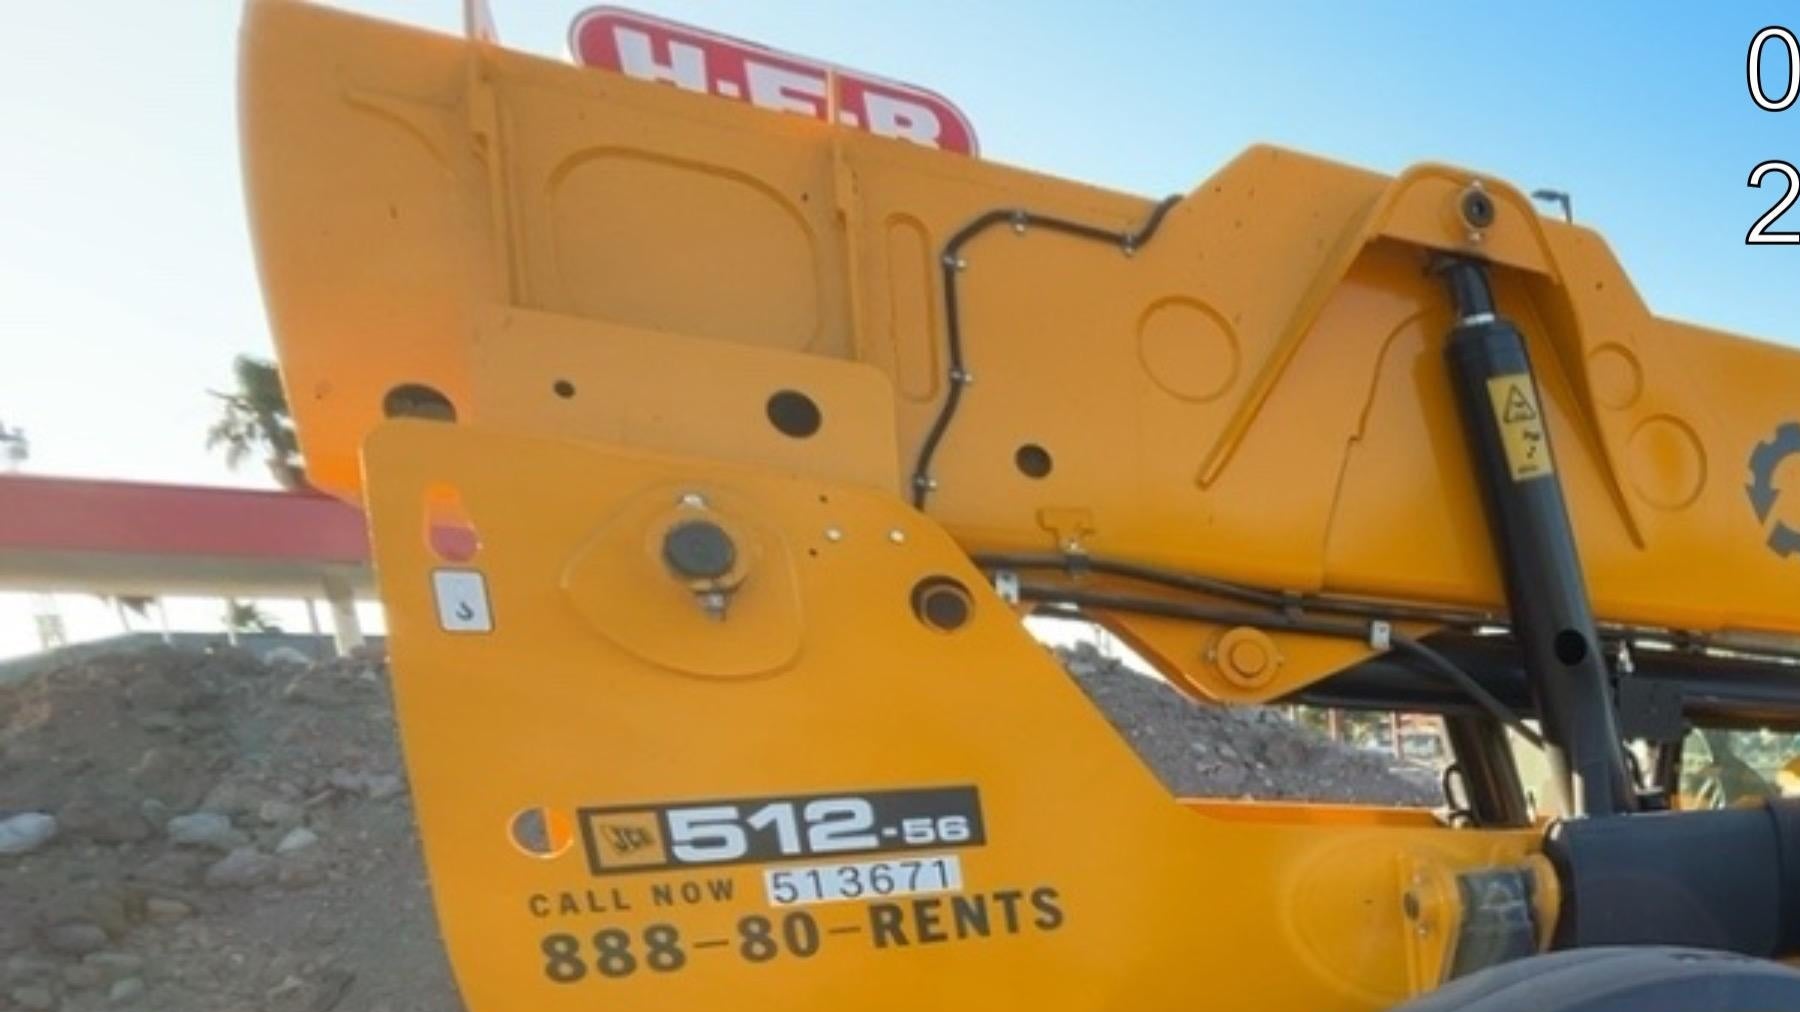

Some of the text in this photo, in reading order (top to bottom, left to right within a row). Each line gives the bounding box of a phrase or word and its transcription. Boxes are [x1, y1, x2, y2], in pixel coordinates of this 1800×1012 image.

[529, 877, 736, 919] CALL NOW
[772, 858, 953, 905] 513671
[541, 886, 1066, 984] 888-80-RENTS
